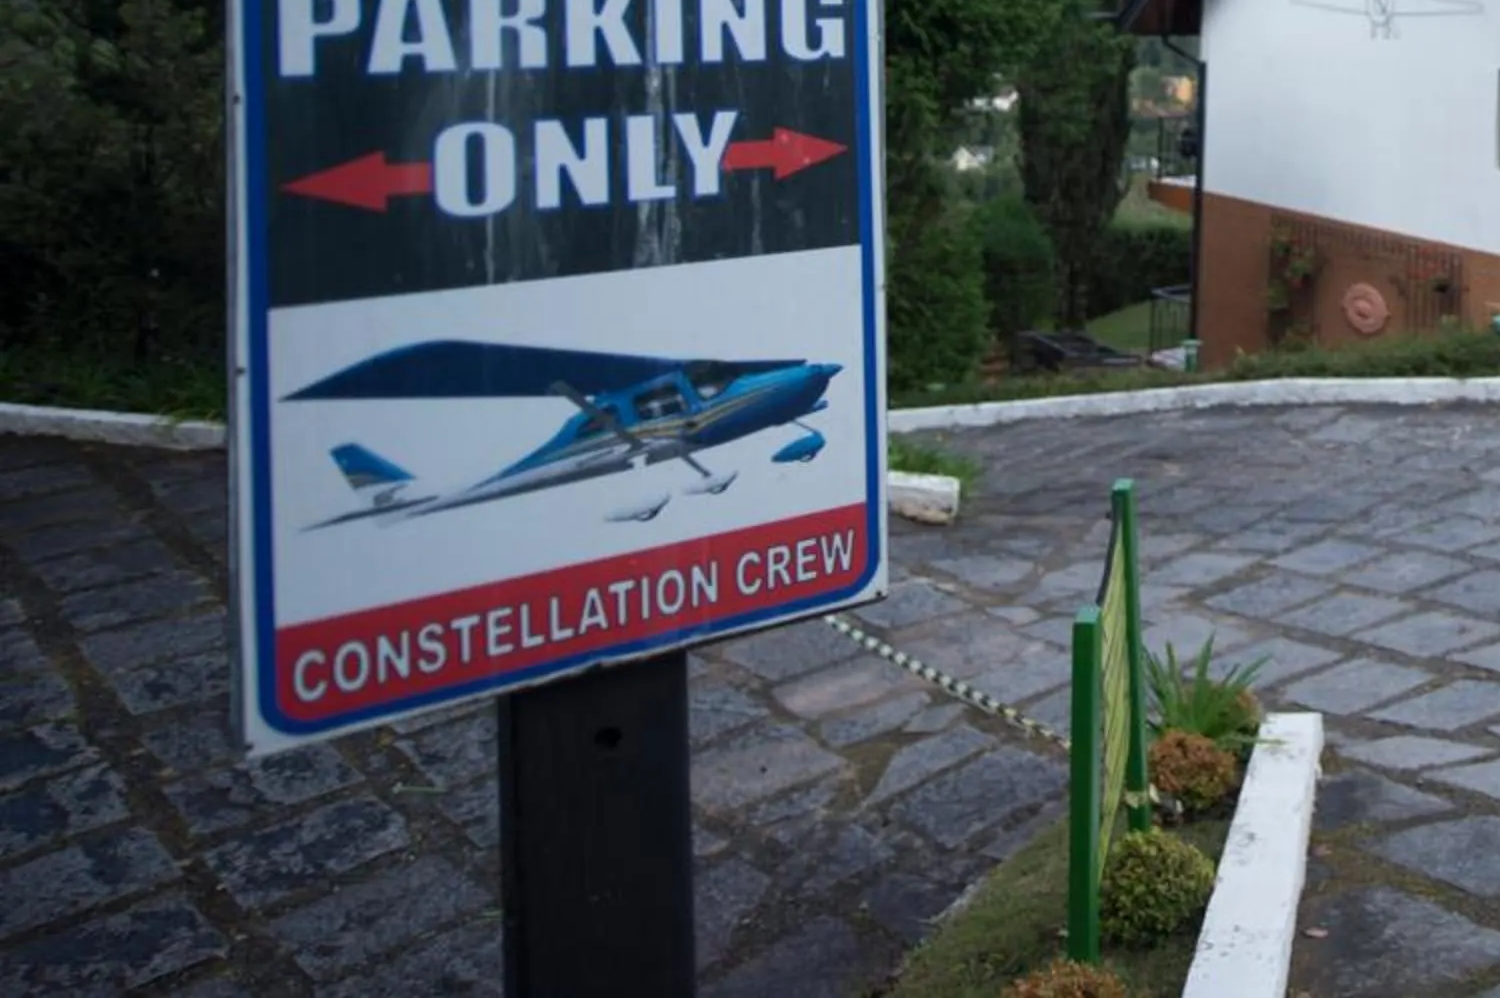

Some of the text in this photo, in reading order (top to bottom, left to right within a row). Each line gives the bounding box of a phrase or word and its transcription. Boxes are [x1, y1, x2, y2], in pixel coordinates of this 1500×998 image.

[433, 111, 738, 217] ONLY
[293, 529, 856, 701] CONSTELLATION CREW
